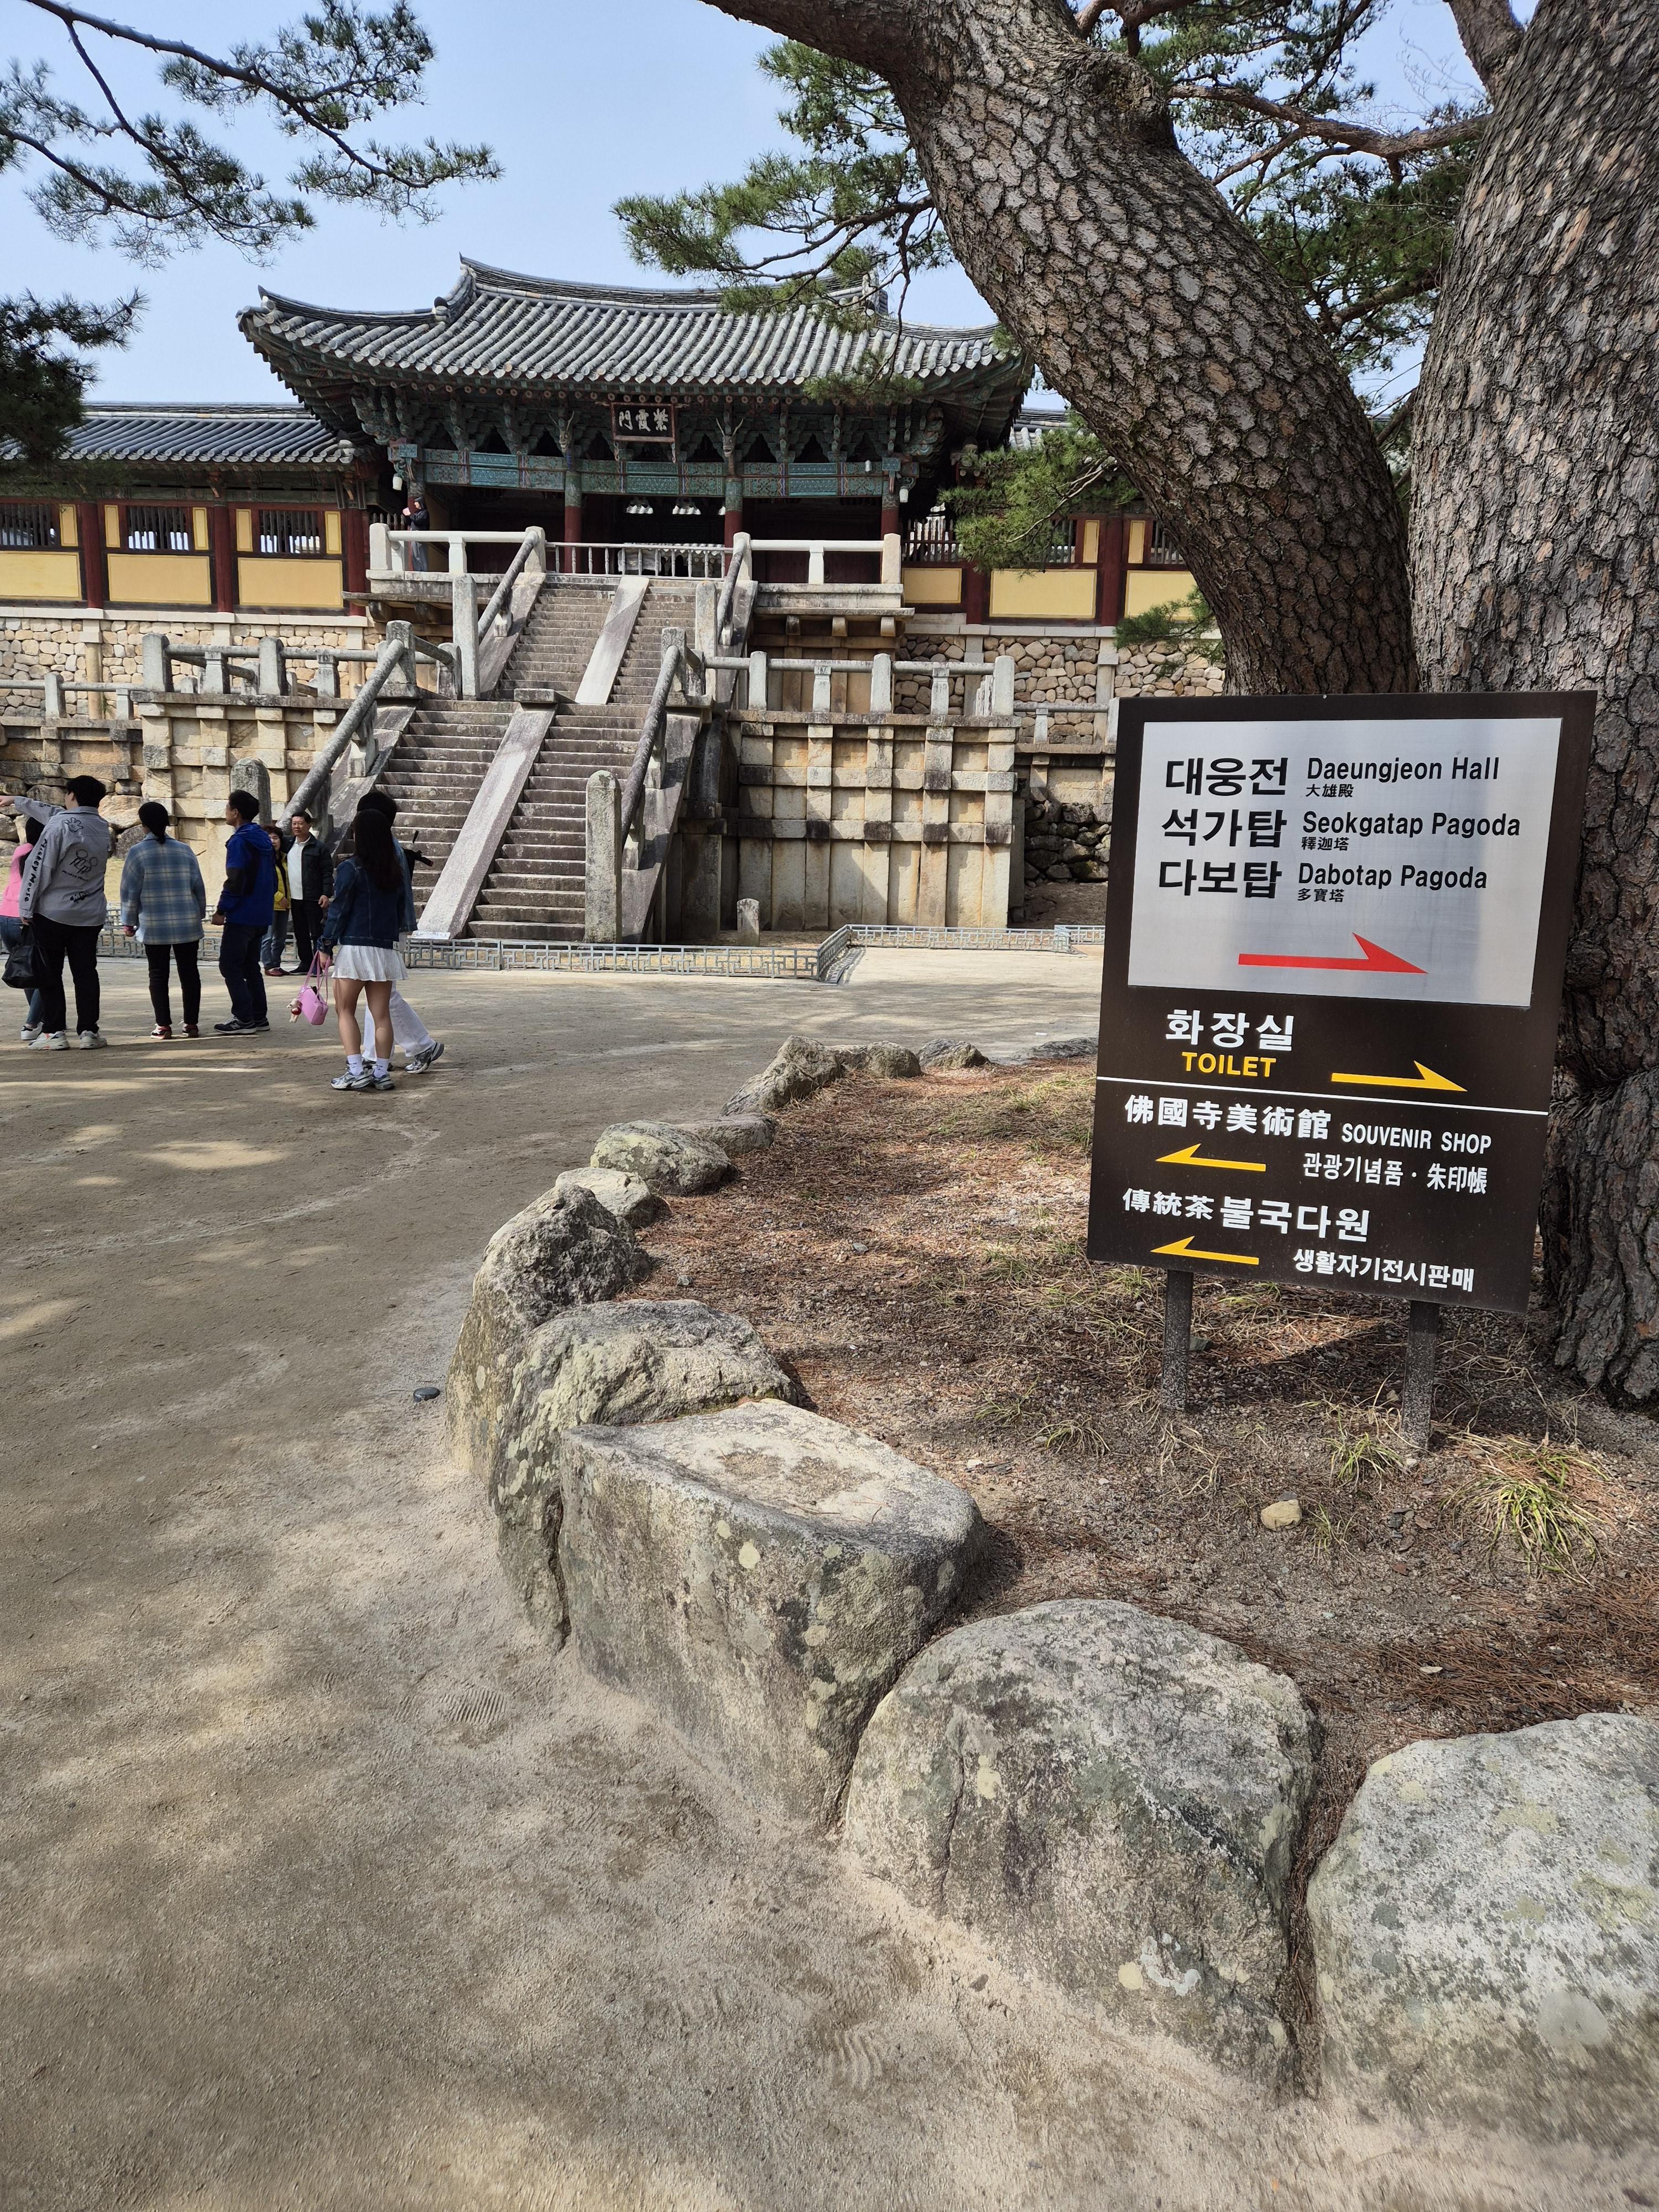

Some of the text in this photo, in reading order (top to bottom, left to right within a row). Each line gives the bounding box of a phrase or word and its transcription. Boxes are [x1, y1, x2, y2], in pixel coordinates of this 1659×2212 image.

[1166, 757, 1288, 796] 대웅전
[1307, 757, 1499, 783] Daeungjeon Hall
[1305, 784, 1354, 798] 大雄殿
[1161, 808, 1287, 848] 석가탑
[1303, 811, 1520, 839] Seokgatap Pagoda
[1301, 836, 1349, 851] 釋迦塔
[1159, 859, 1282, 899] 다보탑
[1298, 862, 1487, 891] Dabotap Pagoda
[1297, 888, 1345, 902] 多寶塔
[1165, 1009, 1294, 1051] 화장실
[1181, 1051, 1277, 1077] TOILET
[1124, 1094, 1332, 1140] 佛國寺美術館
[1341, 1123, 1491, 1154] SOUVENIR SHOP
[1303, 1152, 1404, 1186] 관광기념품
[1427, 1162, 1488, 1194] 朱印帳
[1220, 1196, 1370, 1242] 불국다원
[1292, 1249, 1474, 1292] 생활자기전시판매
